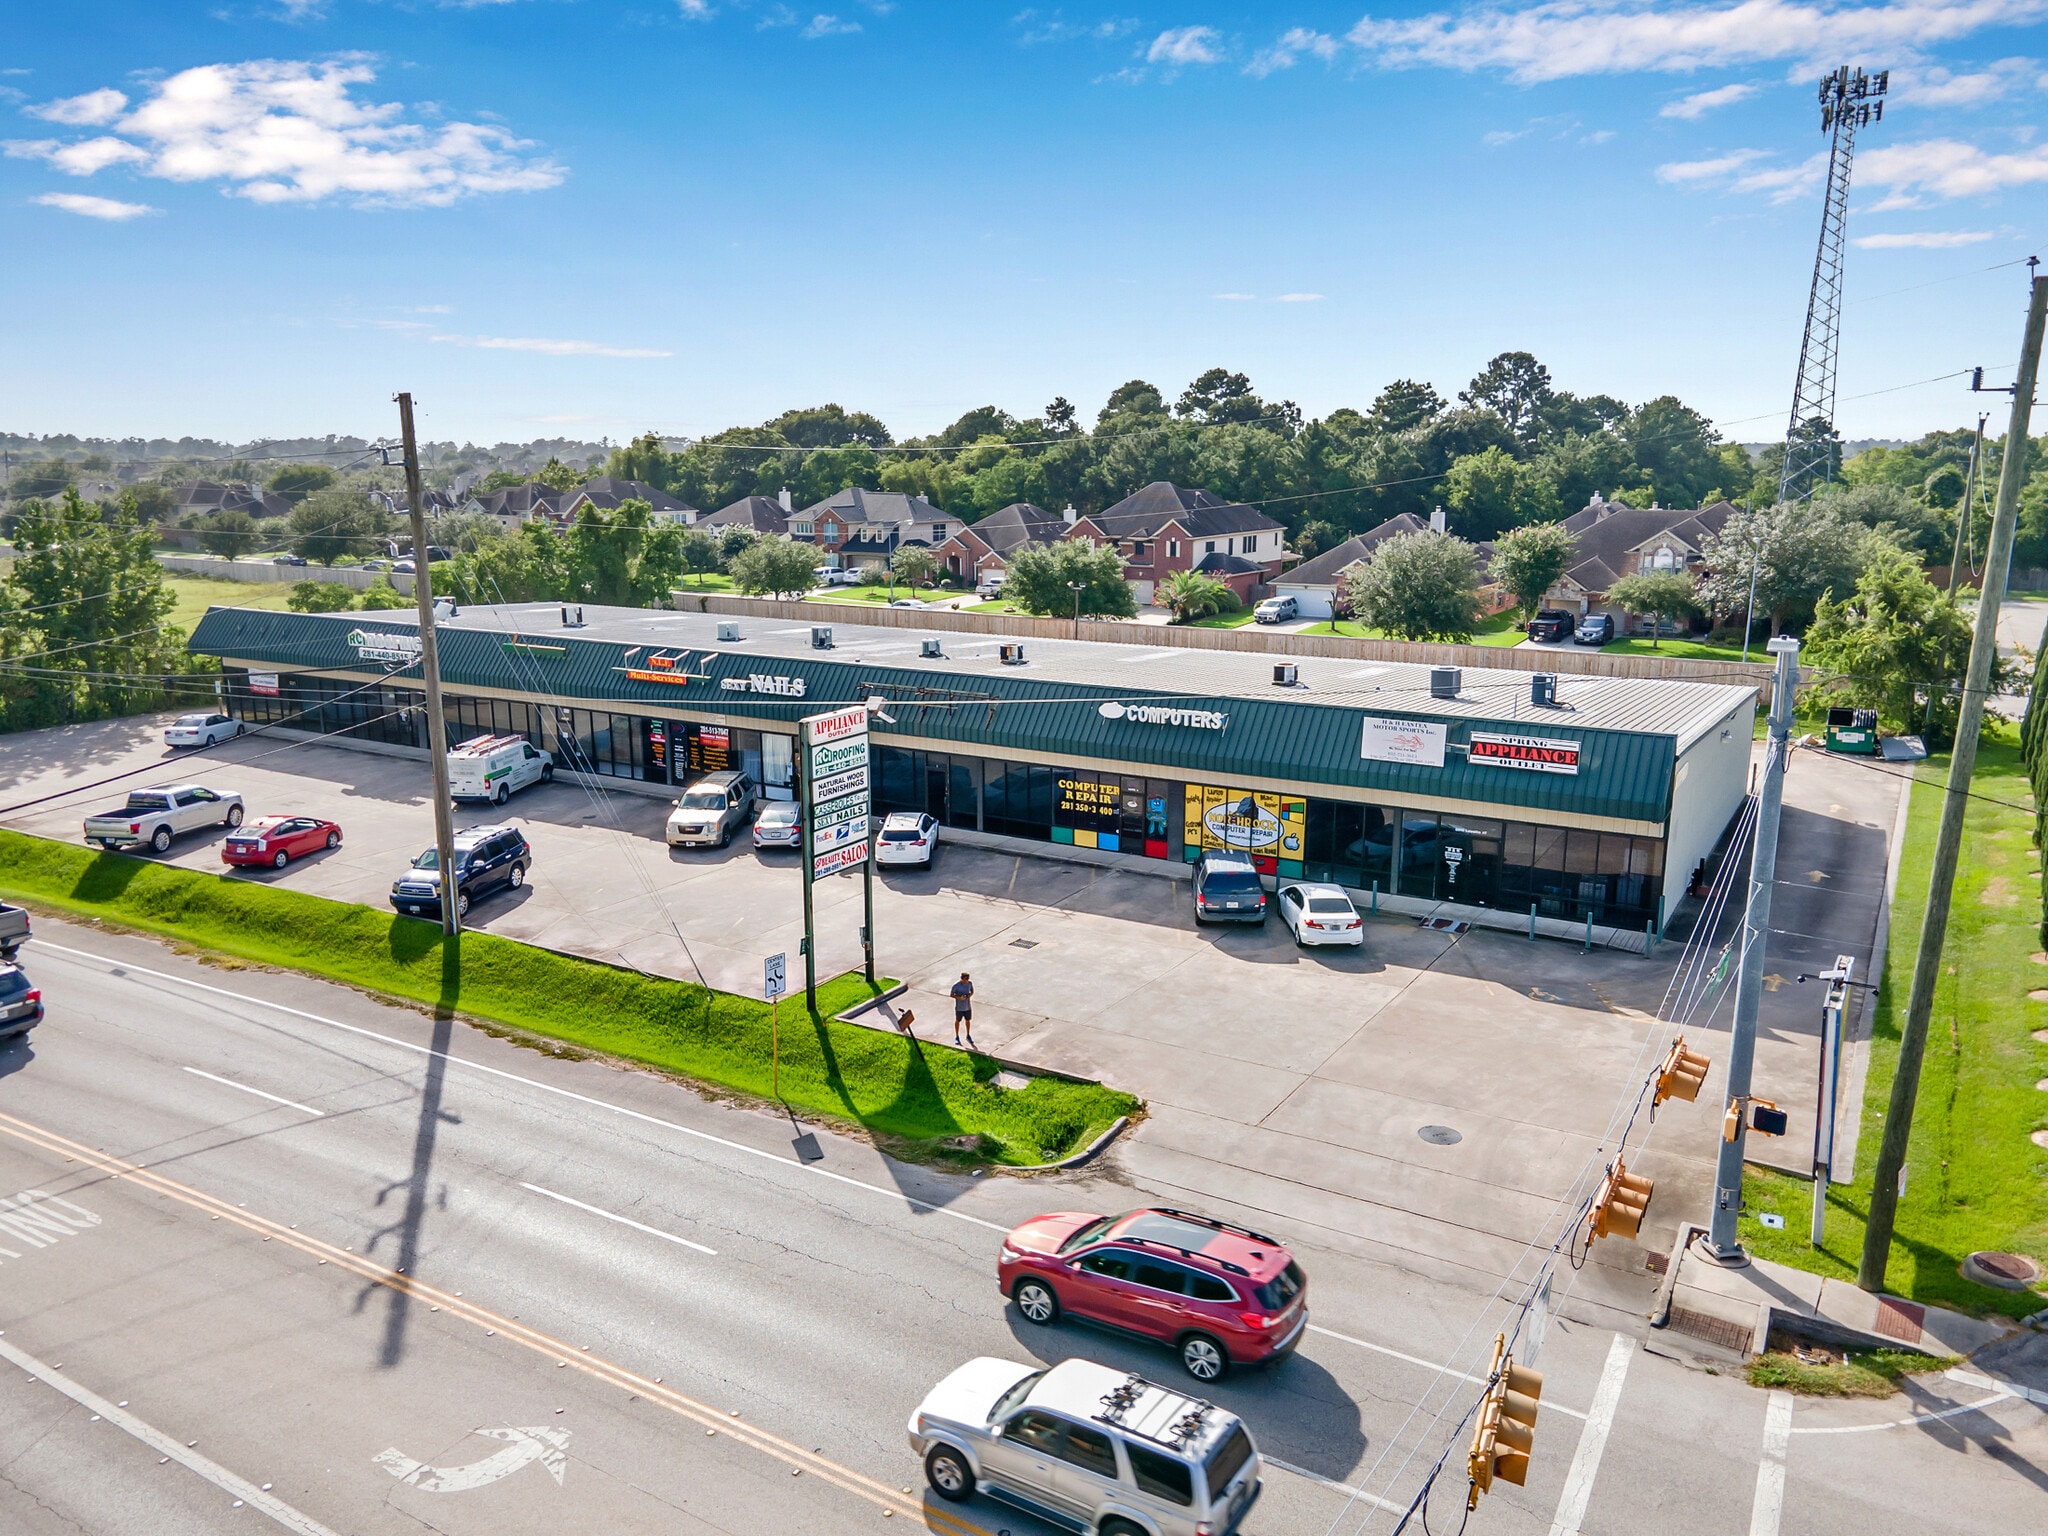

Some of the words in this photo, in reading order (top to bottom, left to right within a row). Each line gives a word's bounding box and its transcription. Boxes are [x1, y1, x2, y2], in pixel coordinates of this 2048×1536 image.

[349, 633, 366, 645] RCI
[630, 671, 684, 684] Multi-Services
[720, 678, 747, 691] SEXY
[749, 674, 806, 697] NAILS
[815, 711, 864, 735] APPLIANCE
[1126, 704, 1224, 730] COMPUTERS
[828, 728, 852, 738] OUTLET
[1373, 724, 1398, 732] MOTOR
[1399, 726, 1425, 734] SPORTS
[1500, 736, 1548, 748] SPRING
[816, 749, 832, 765] RCI
[833, 743, 865, 762] ROOFING
[1472, 741, 1577, 765] APPLIANCE
[1499, 758, 1548, 770] OUTLET
[818, 777, 845, 790] NATURAL
[847, 771, 864, 781] WOOD
[819, 778, 864, 798] FURNISHINGS
[1058, 779, 1120, 796] COMPUTER
[1065, 790, 1113, 804] REPAIR
[836, 805, 864, 821] NAILS
[1212, 823, 1246, 834] COMPUTER
[1252, 828, 1274, 838] REPAIR
[841, 842, 868, 866] SALON
[770, 961, 781, 969] LANE
